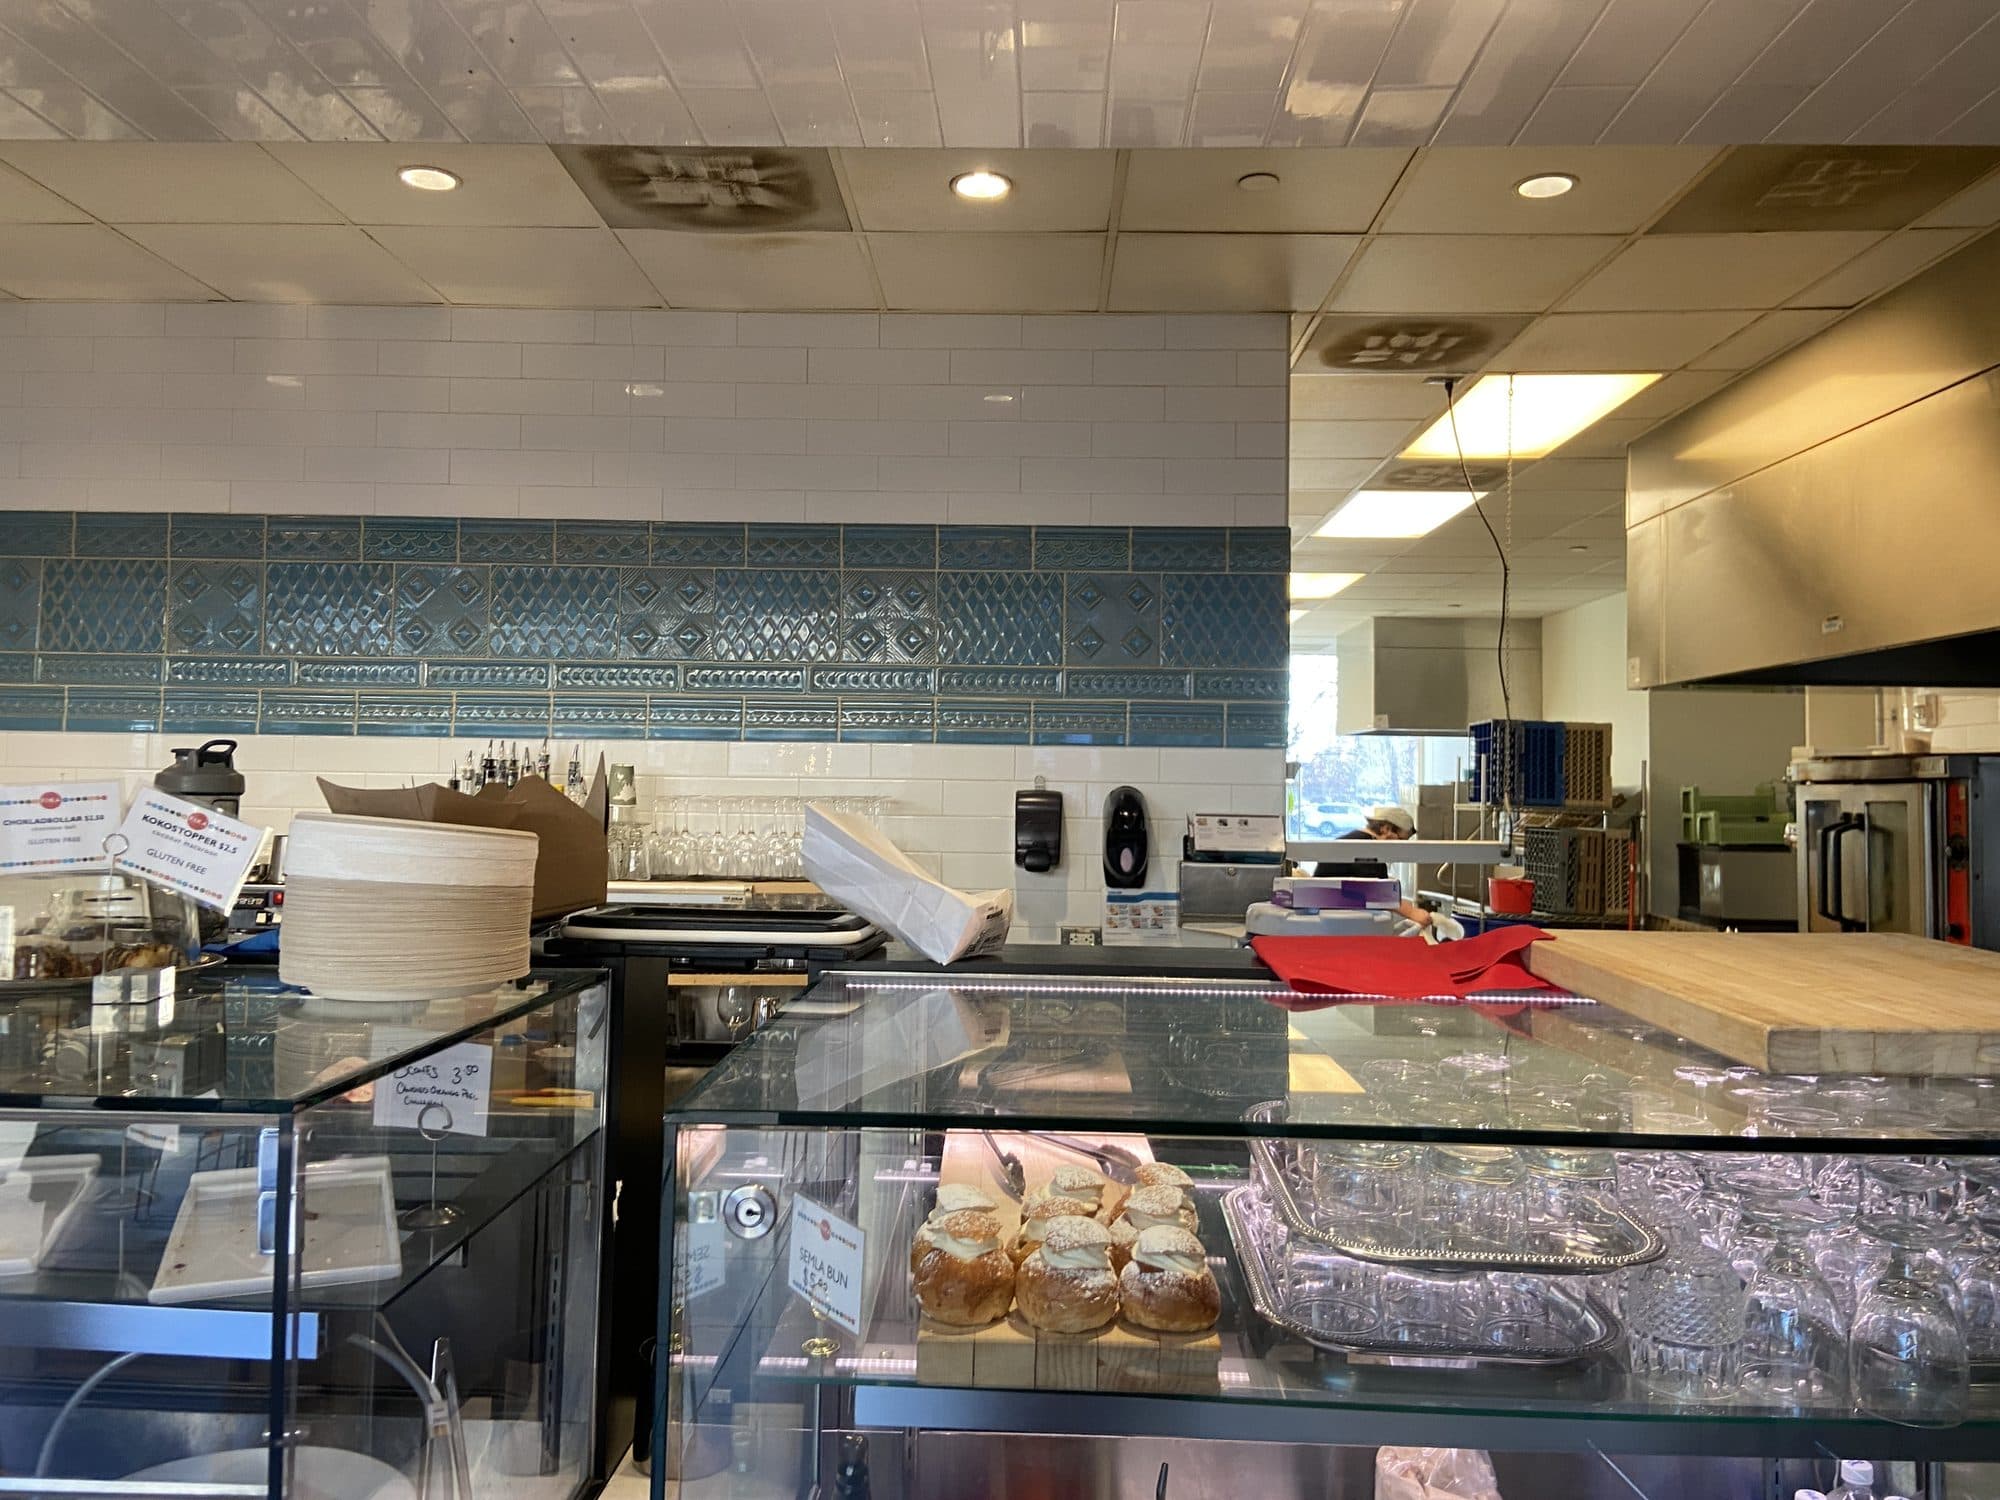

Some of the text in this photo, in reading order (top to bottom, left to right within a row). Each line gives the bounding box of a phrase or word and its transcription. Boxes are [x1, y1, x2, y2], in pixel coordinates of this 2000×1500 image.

[142, 814, 217, 847] KOKOSTOPPER
[146, 848, 207, 874] GLUTEN FREE
[800, 1247, 848, 1289] SEMLA BUN
